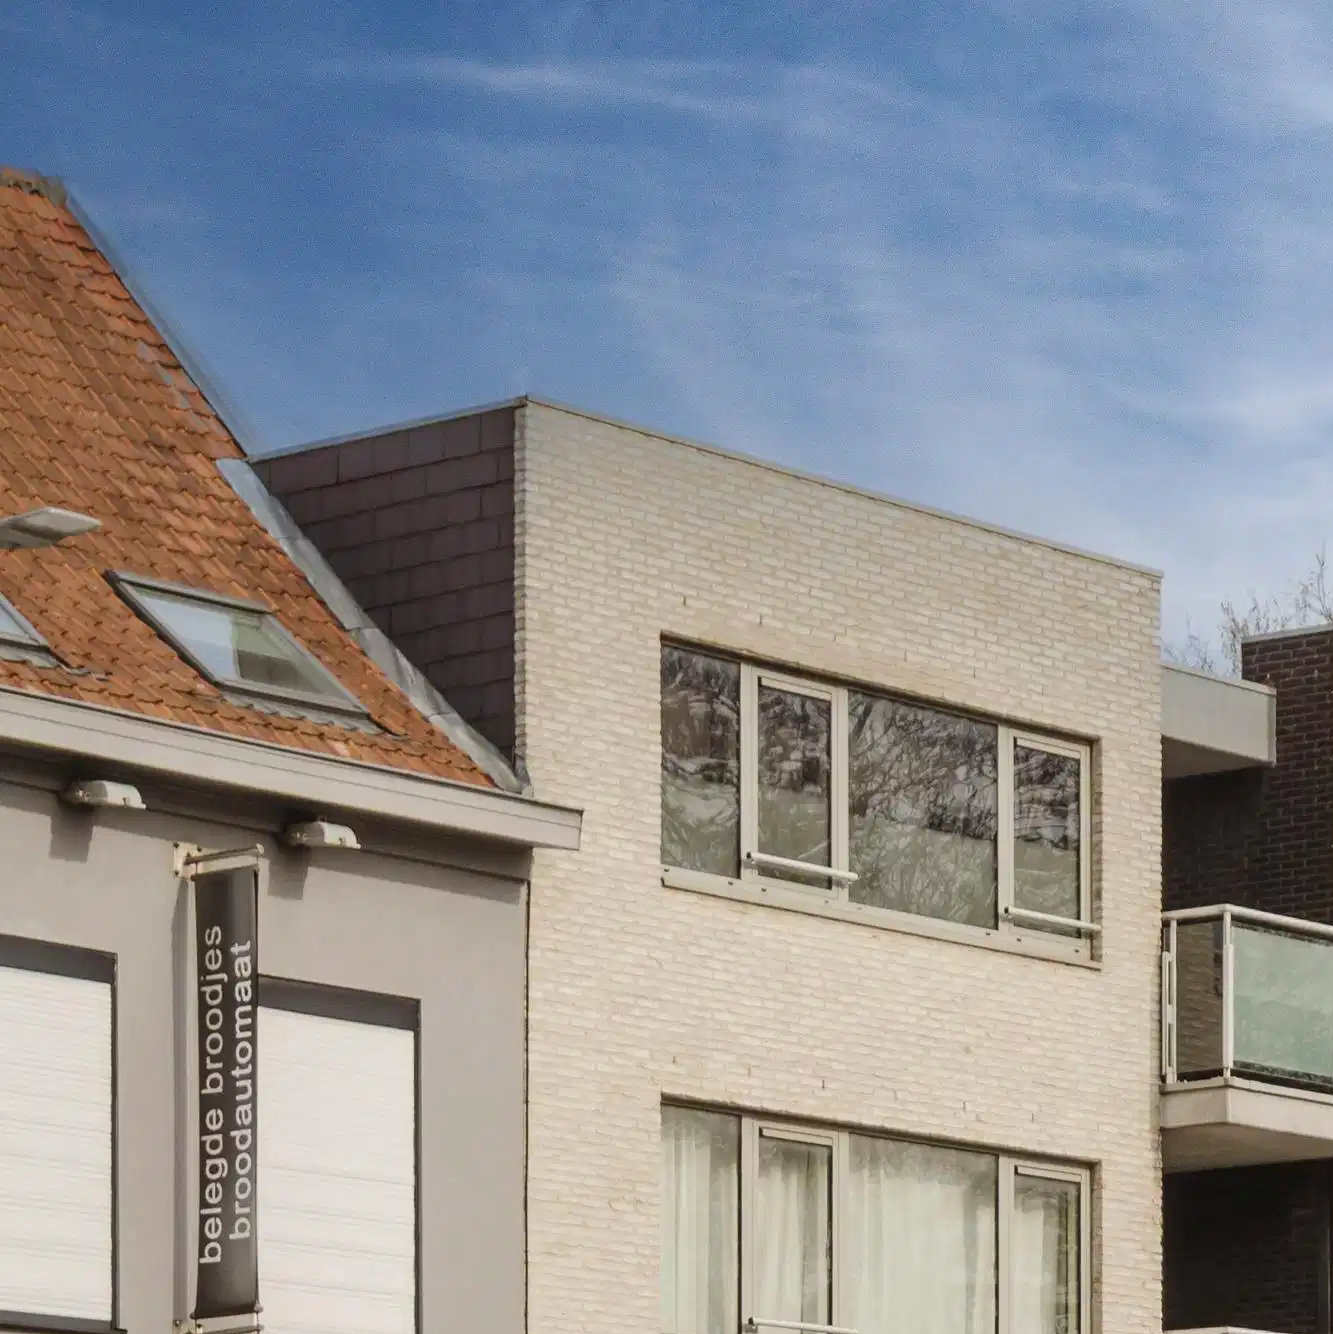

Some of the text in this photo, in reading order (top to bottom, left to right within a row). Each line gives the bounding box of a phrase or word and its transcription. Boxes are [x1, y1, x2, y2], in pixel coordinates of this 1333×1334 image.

[199, 924, 228, 1264] belegde broodjes
[229, 940, 252, 1240] broodautomaat
